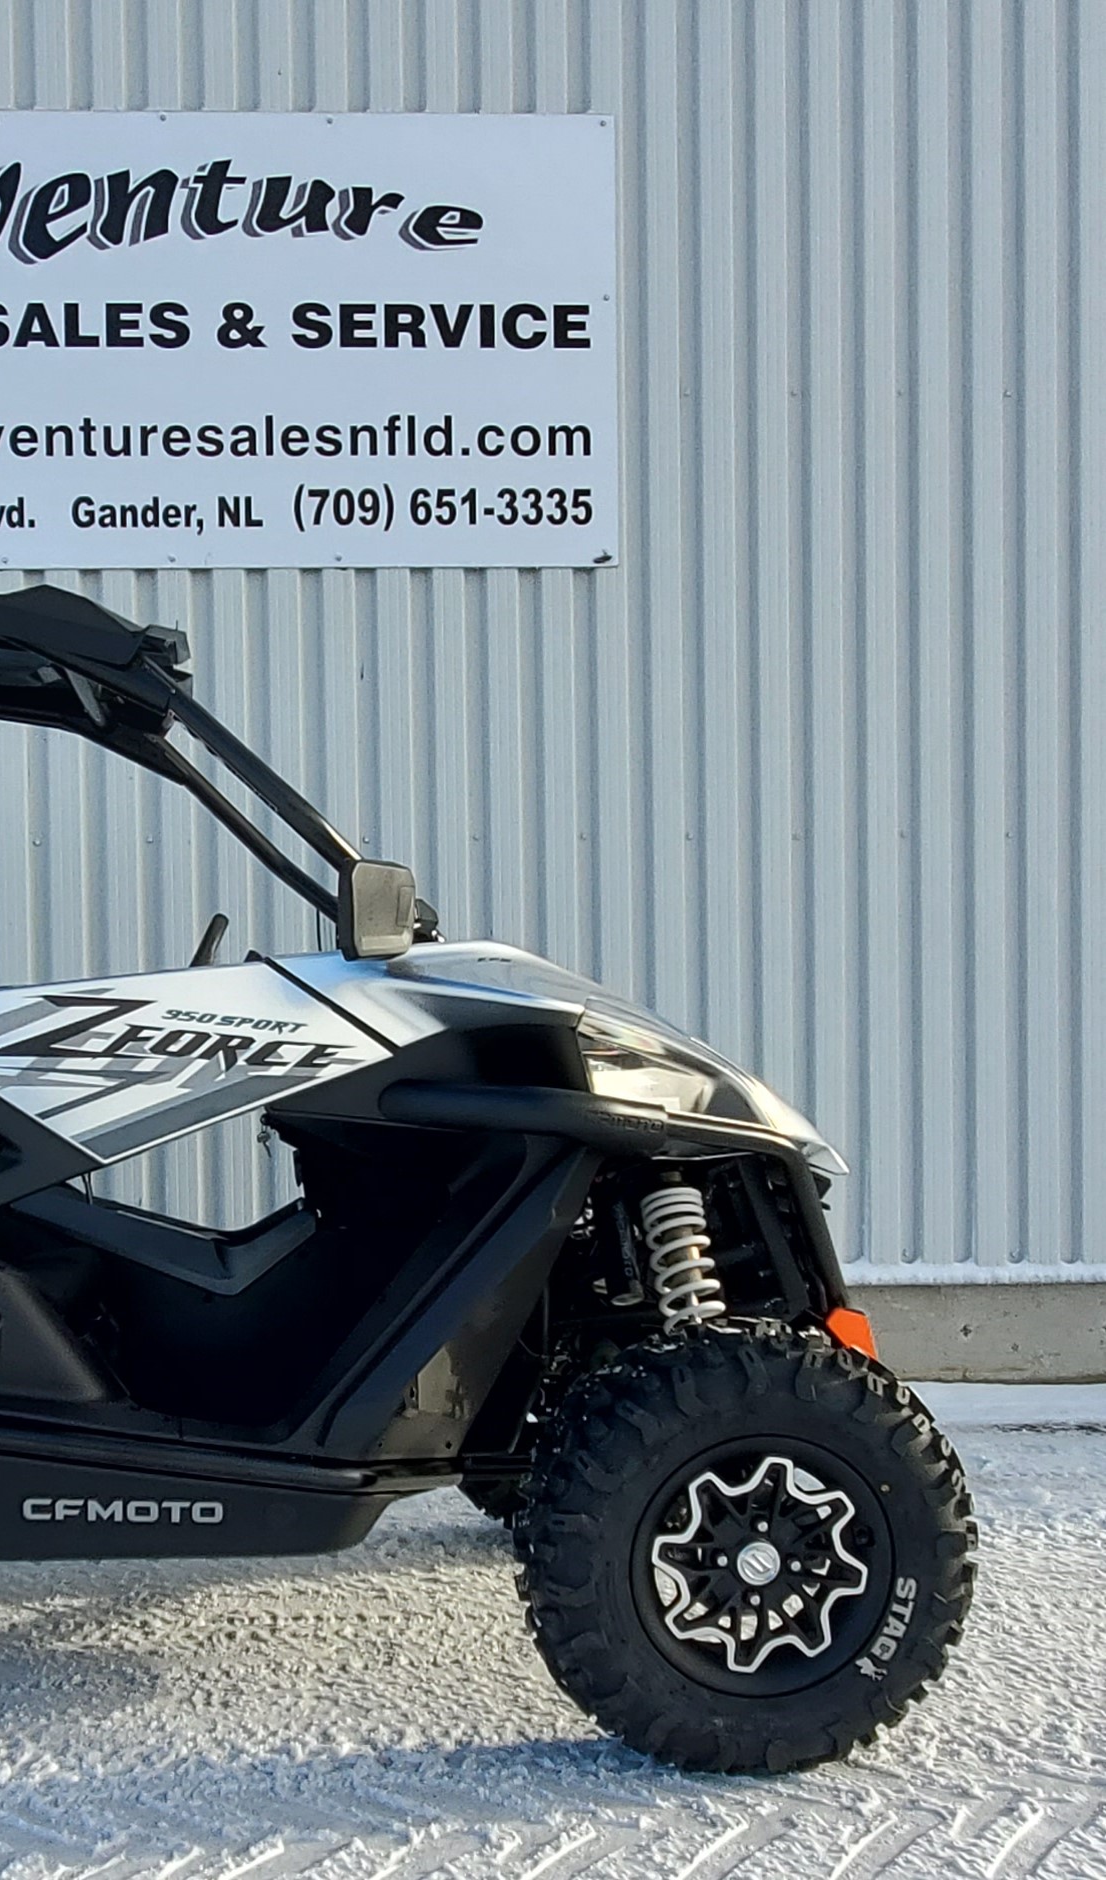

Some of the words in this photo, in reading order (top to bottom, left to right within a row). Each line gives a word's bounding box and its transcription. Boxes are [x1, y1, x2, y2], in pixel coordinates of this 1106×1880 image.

[216, 302, 267, 349] &
[291, 302, 591, 350] SERVICE
[71, 496, 204, 536] Gander,
[217, 496, 264, 528] NL
[293, 483, 395, 532] (709)
[409, 487, 593, 527] 651-3335
[161, 1009, 217, 1024] 950
[221, 1015, 309, 1035] SPORT
[22, 1498, 224, 1524] CFMOTO
[871, 1577, 917, 1661] STAG
